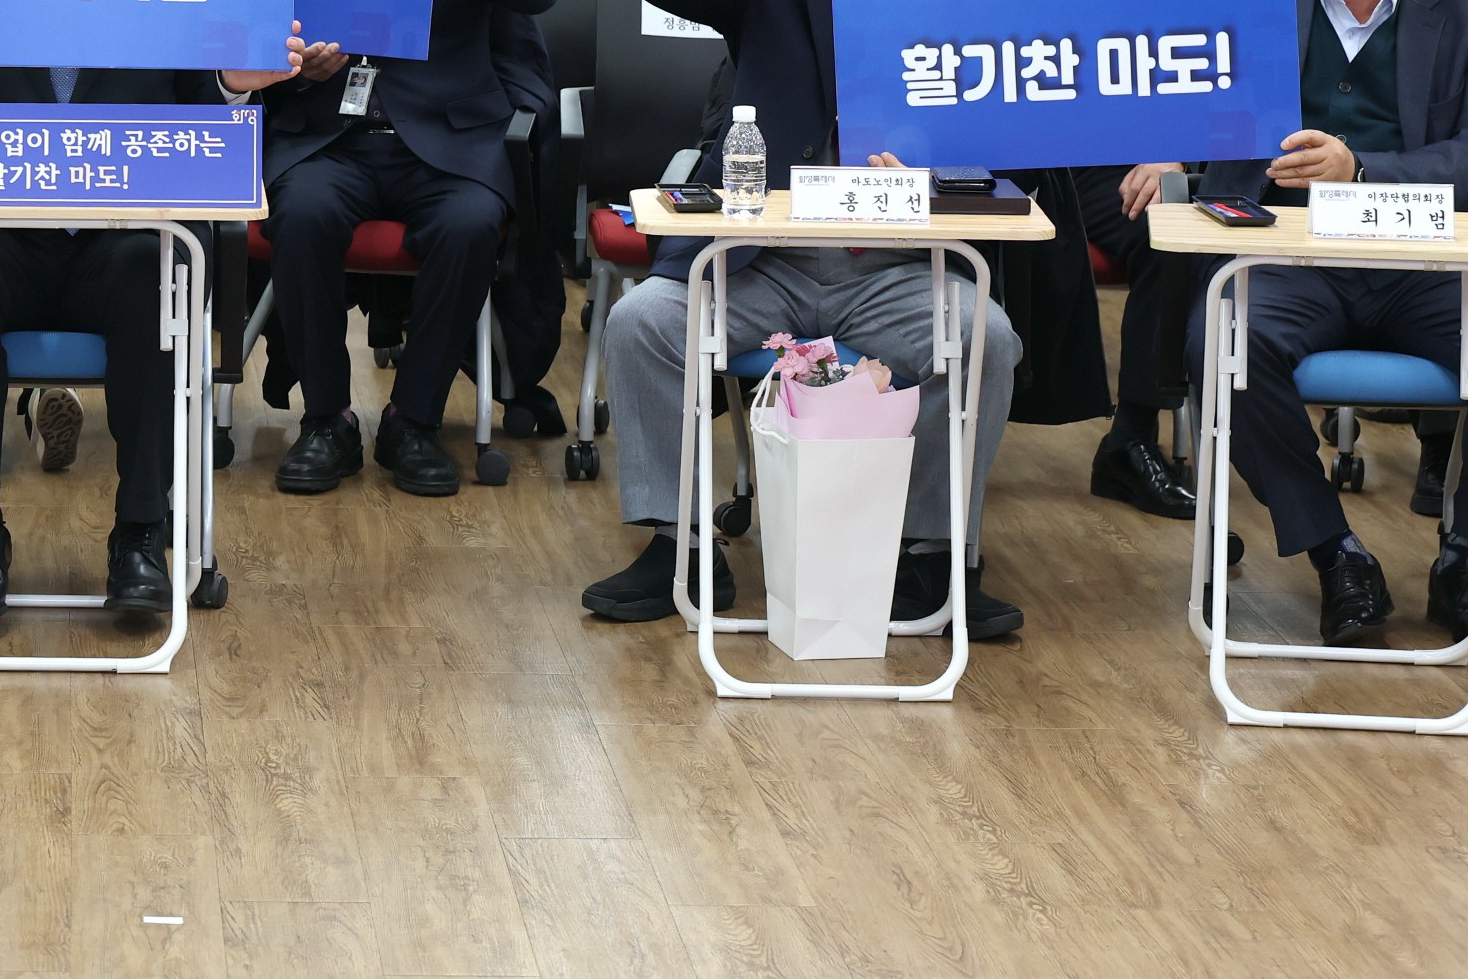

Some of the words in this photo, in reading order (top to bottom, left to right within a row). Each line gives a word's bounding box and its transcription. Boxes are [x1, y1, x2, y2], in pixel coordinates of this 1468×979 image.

[901, 37, 1080, 107] 활기찬
[1096, 31, 1232, 97] 마도!
[60, 128, 112, 158] 함께
[121, 129, 226, 158] 공존하는
[68, 163, 129, 191] 마도!
[851, 176, 915, 188] 마도노인회장
[1368, 192, 1444, 204] 이장단협의회장
